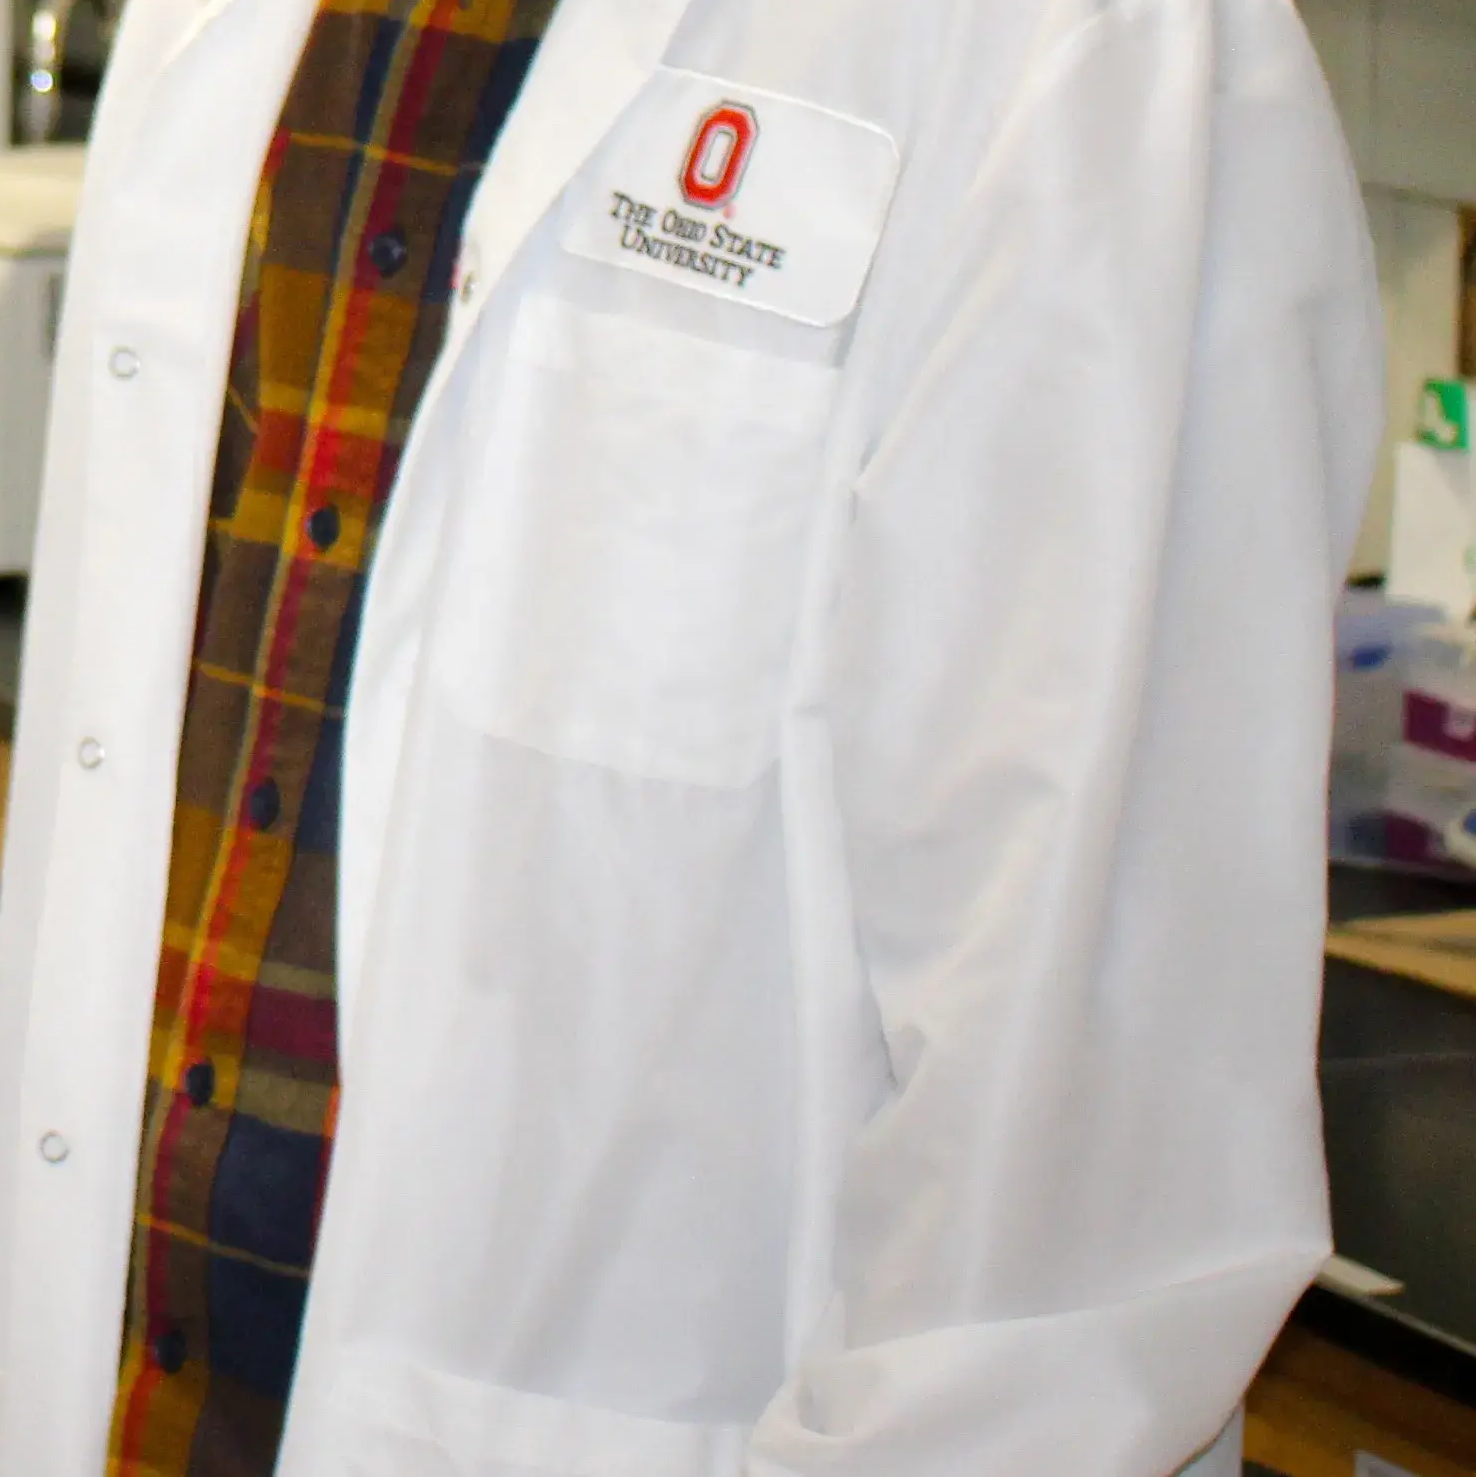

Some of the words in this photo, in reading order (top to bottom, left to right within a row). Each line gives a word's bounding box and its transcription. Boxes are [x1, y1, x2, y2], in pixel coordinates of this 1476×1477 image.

[609, 191, 658, 227] THE
[661, 208, 707, 242] OHIO
[709, 223, 786, 269] STATE
[620, 225, 754, 289] UNIVERSITY
